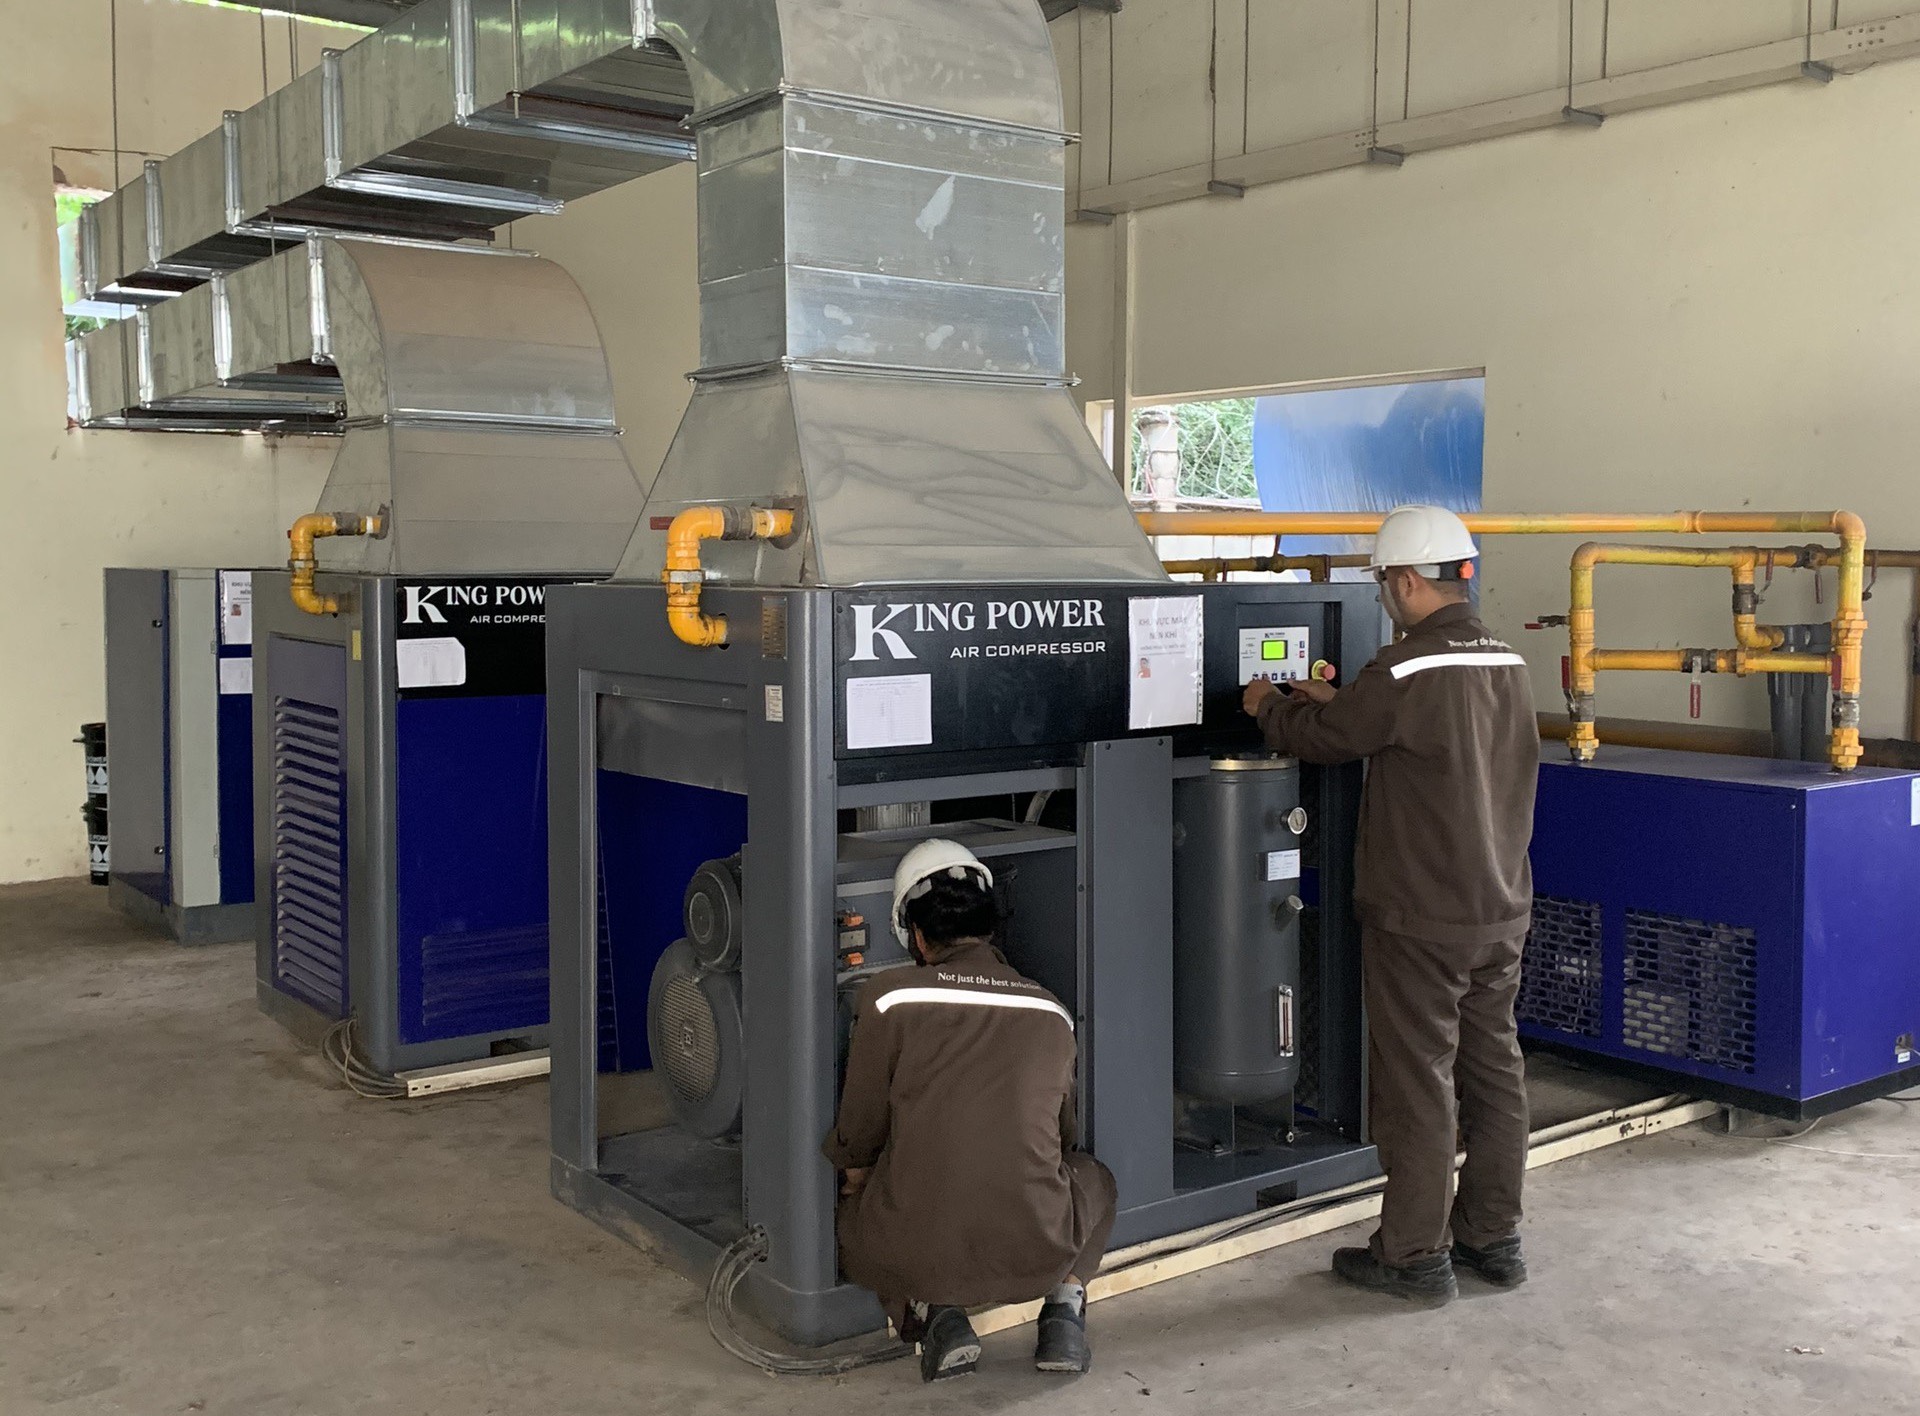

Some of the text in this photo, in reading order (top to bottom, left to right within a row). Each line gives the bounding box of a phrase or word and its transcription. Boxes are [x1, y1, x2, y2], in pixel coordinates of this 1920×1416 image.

[402, 586, 488, 623] KING
[470, 615, 490, 624] AIR
[849, 599, 1105, 661] KING POWER
[950, 641, 1106, 659] AIR COMPRESSOR
[937, 972, 956, 982] Not
[957, 974, 974, 985] just
[976, 975, 990, 985] the
[991, 977, 1009, 987] best
